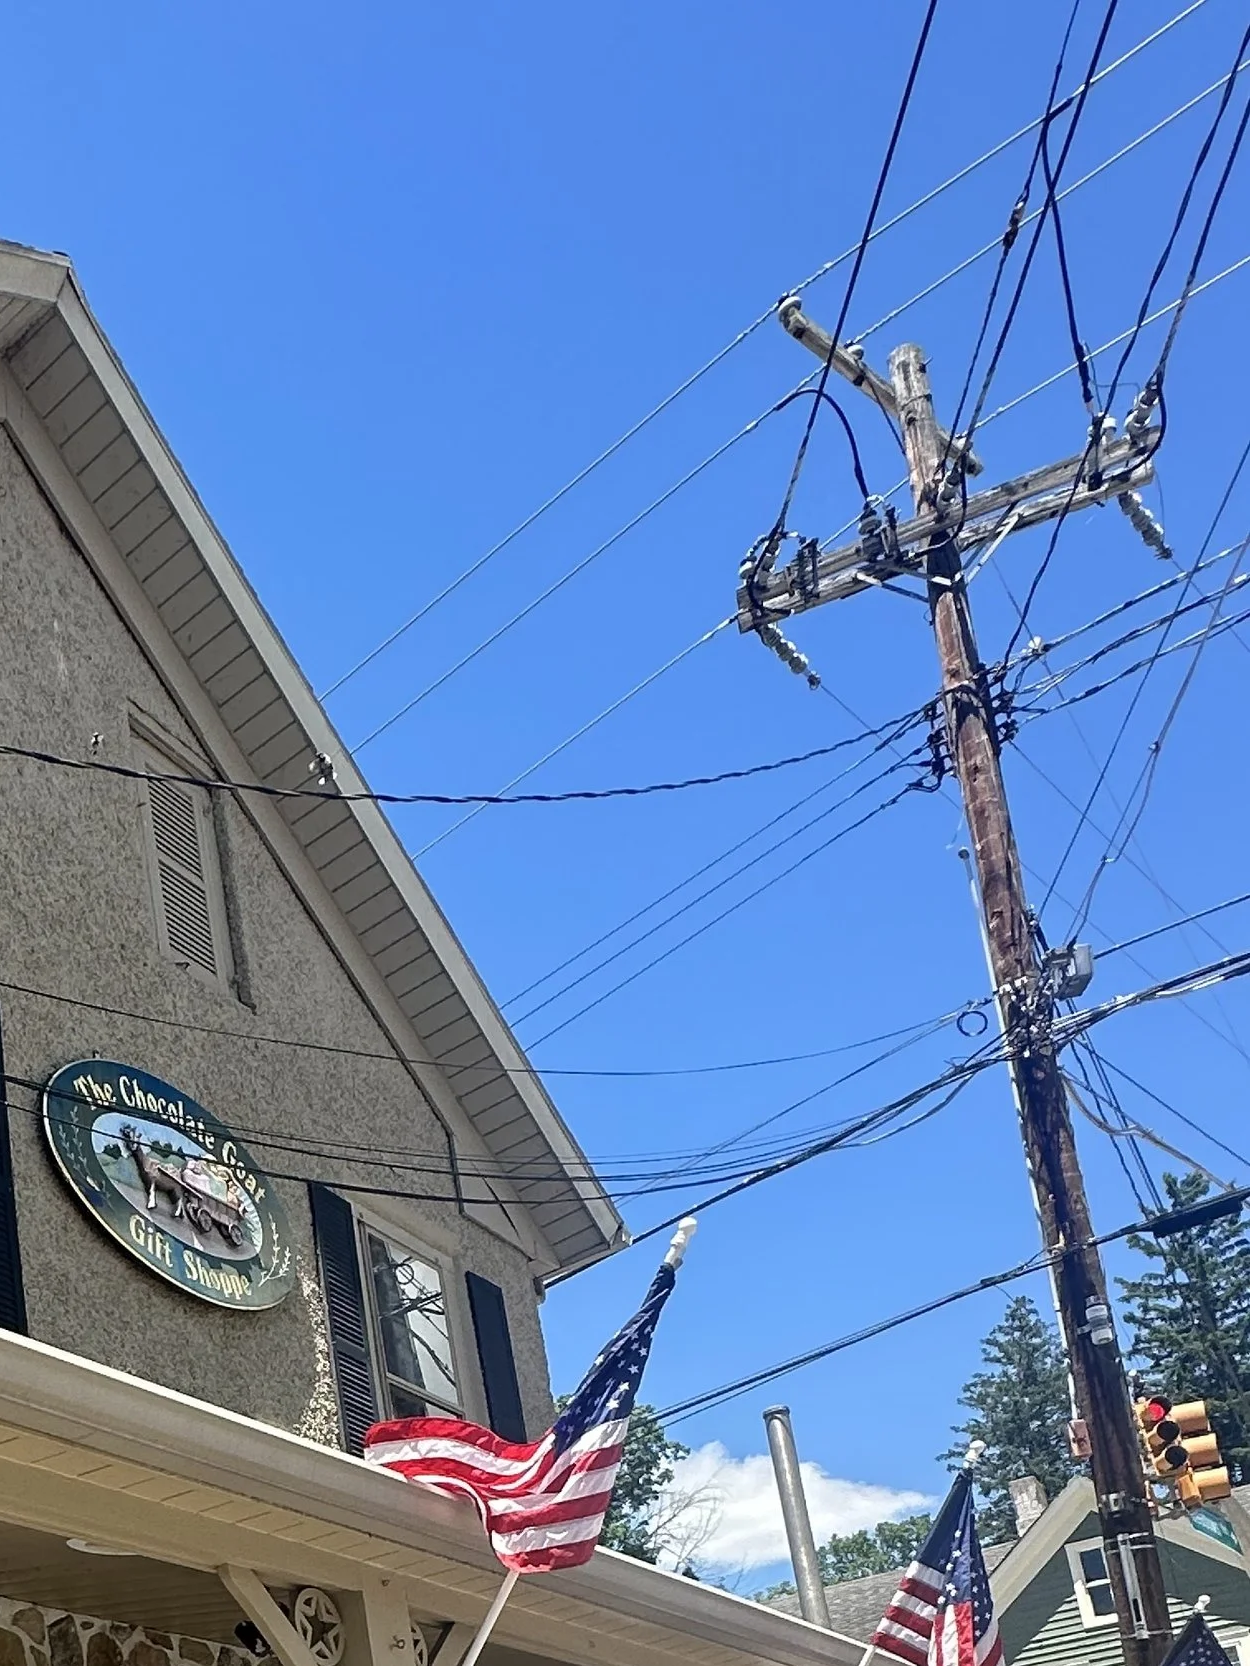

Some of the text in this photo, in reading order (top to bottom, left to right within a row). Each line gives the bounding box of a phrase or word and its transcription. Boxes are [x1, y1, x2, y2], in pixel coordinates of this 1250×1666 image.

[72, 1073, 266, 1203] The Chocolate Goat
[129, 1214, 253, 1300] Gift Shoppe
